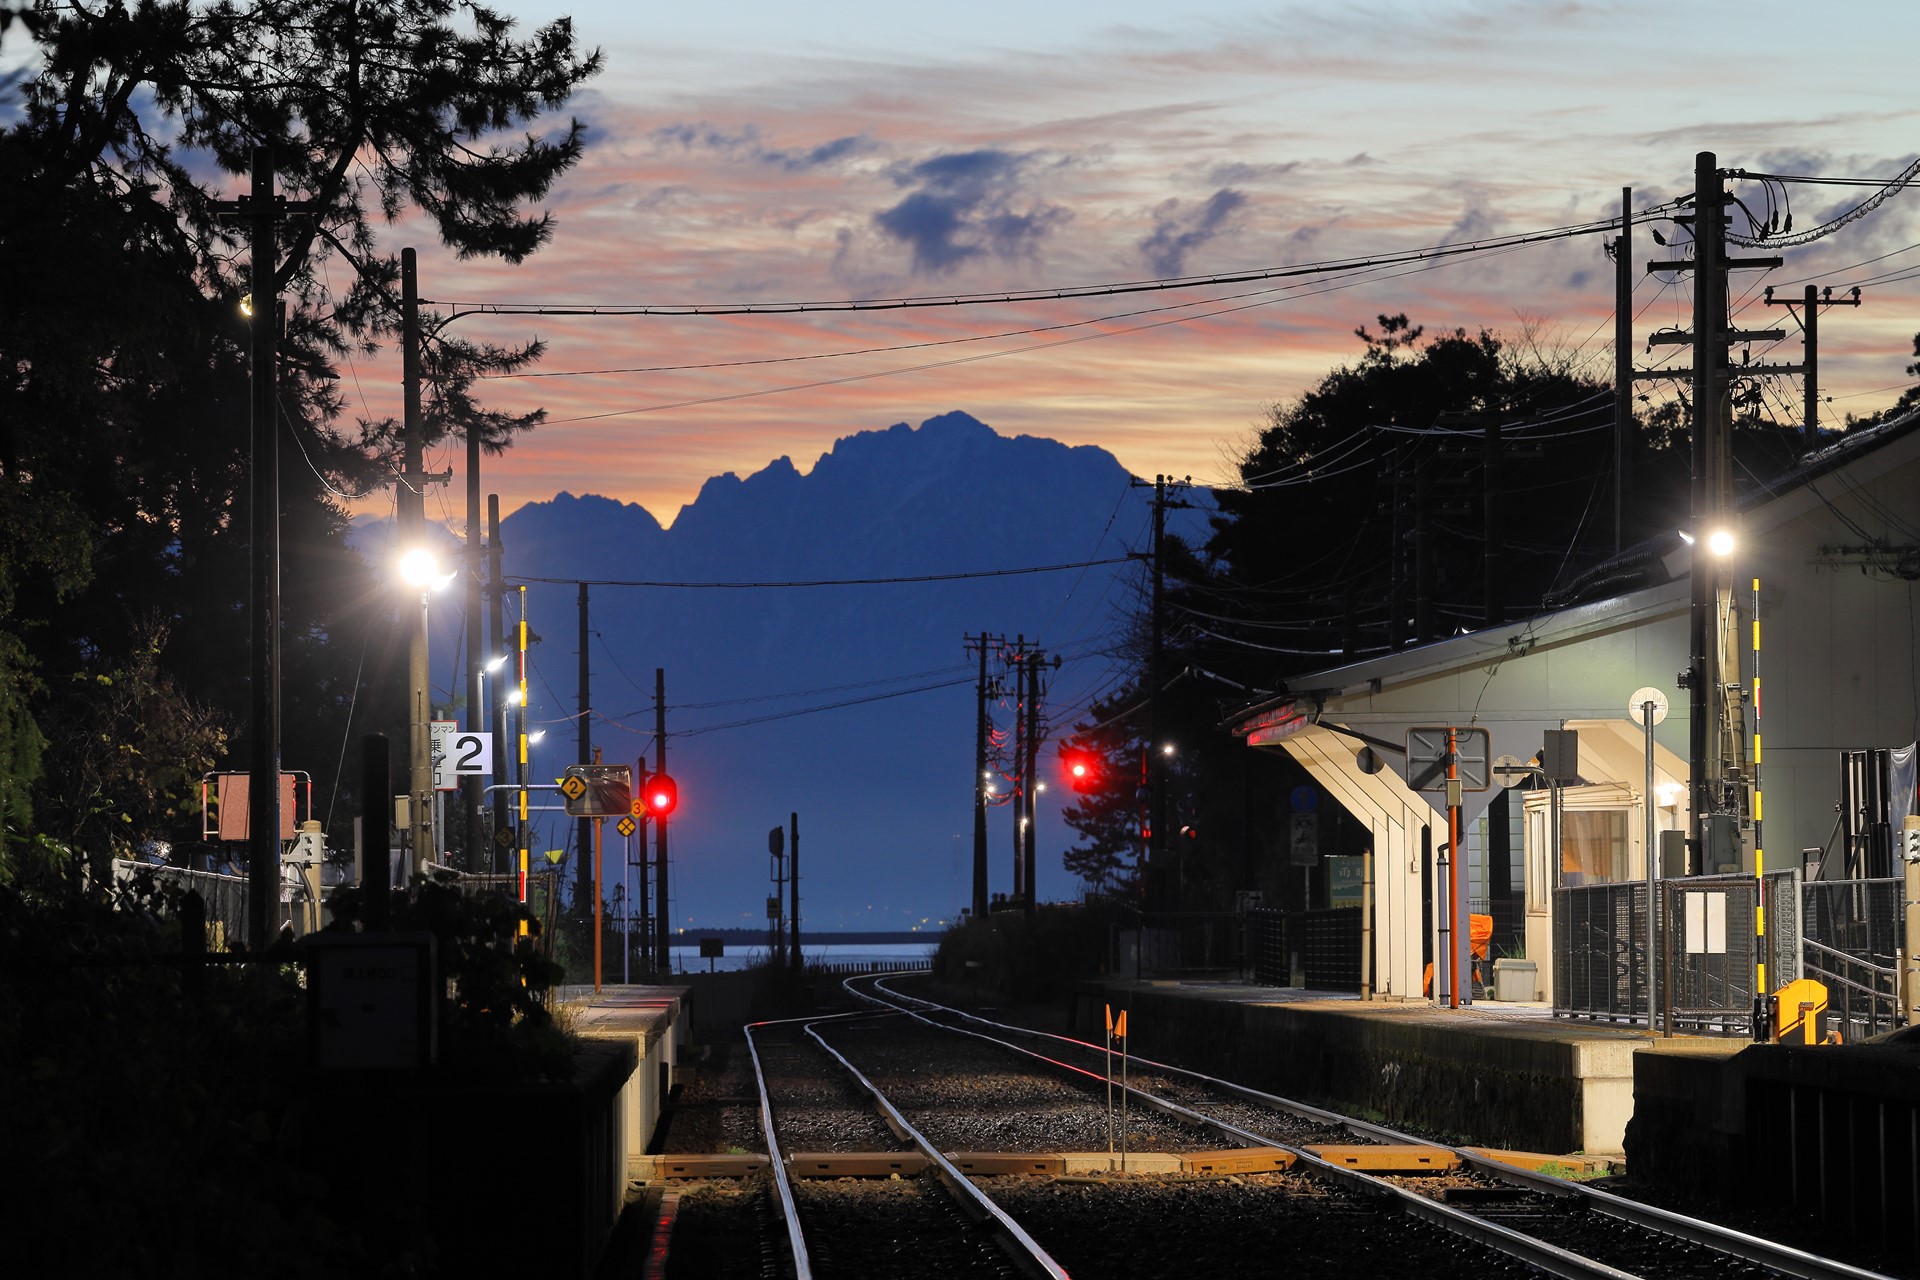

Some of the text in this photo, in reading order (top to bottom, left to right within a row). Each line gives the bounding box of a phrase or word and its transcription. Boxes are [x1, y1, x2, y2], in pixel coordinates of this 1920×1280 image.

[431, 726, 456, 734] ンマン
[456, 736, 483, 770] 2
[569, 781, 579, 794] 2
[633, 802, 641, 815] 3
[500, 831, 510, 844] 3
